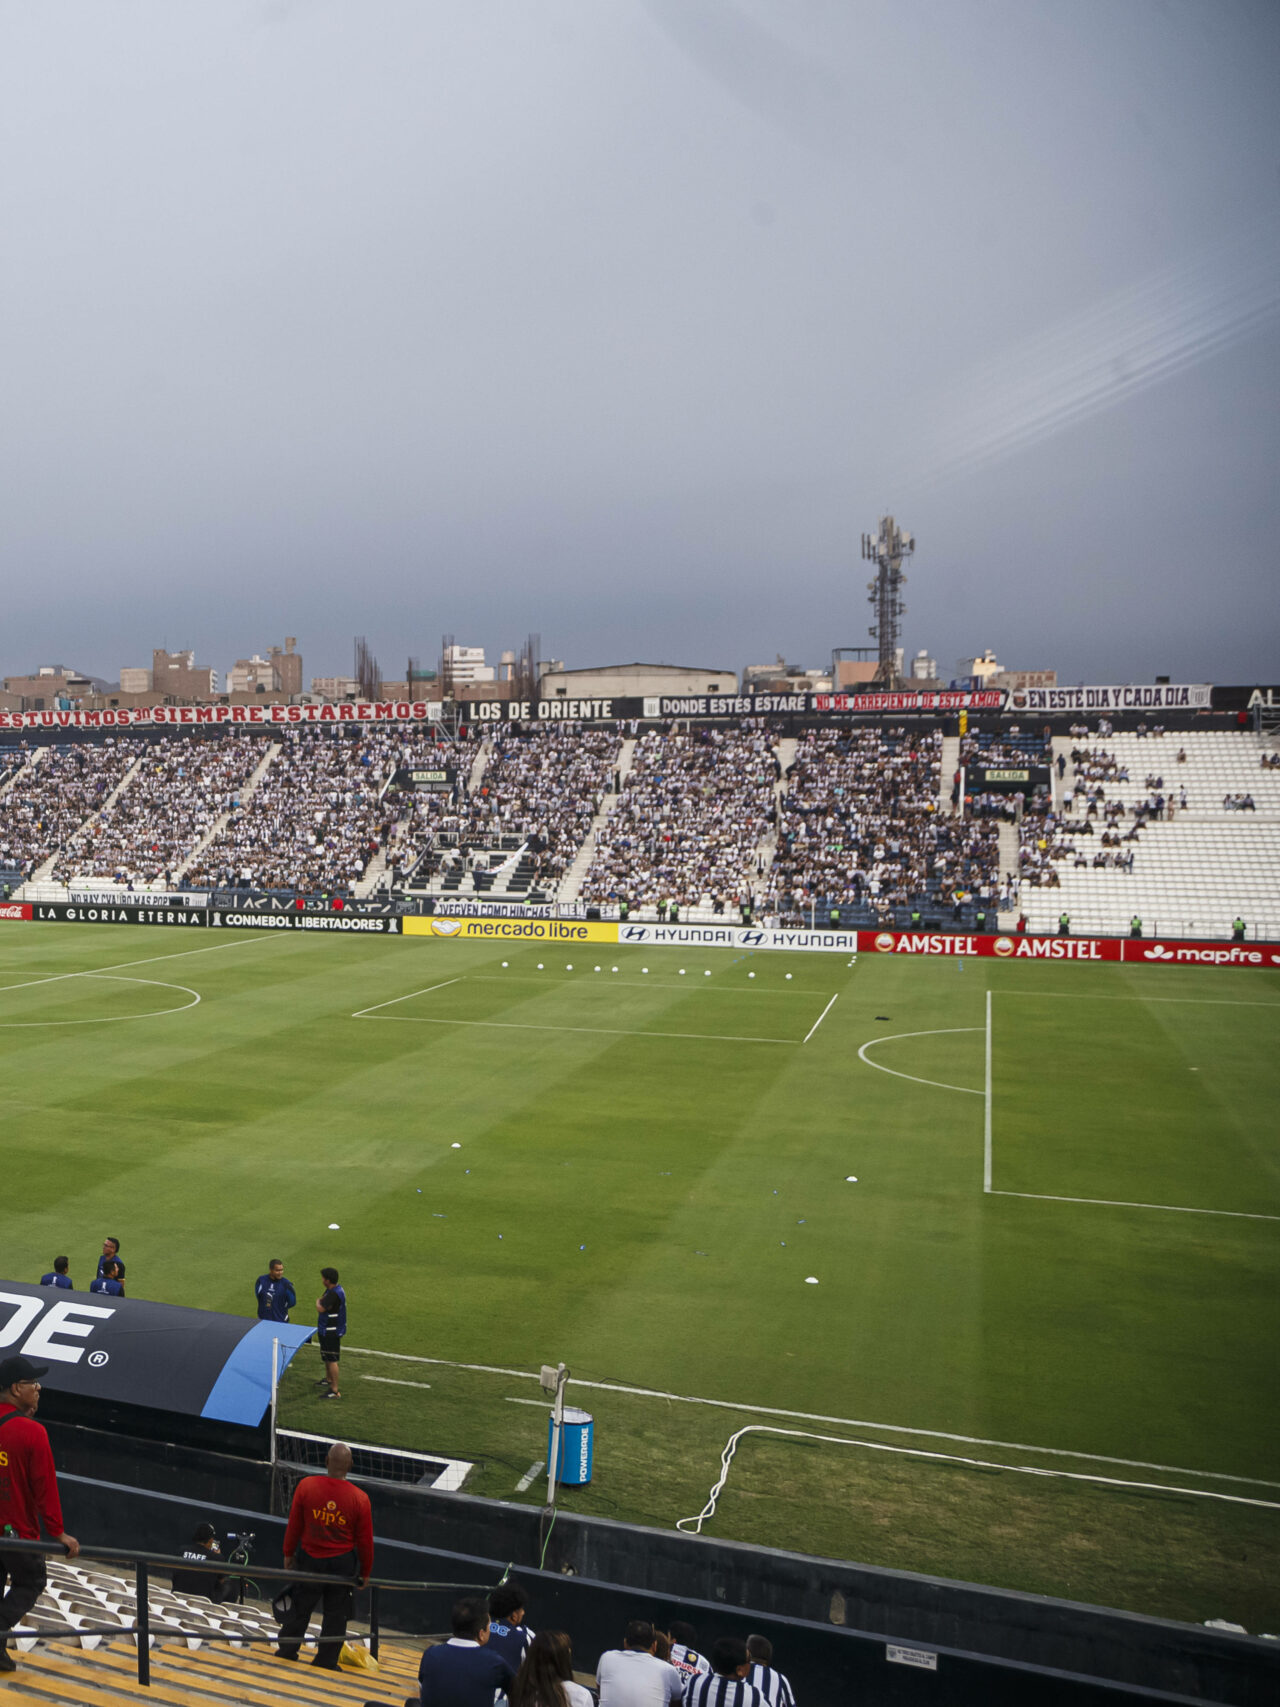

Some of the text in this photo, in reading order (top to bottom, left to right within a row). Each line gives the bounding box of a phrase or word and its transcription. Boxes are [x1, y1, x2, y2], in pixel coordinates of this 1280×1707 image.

[663, 695, 806, 714] DONDE ESTÉS ESTARÉ
[815, 691, 1002, 711] NO ME ARREPIENTO DE ESTE AMOR
[1028, 687, 1190, 708] EN ESTE DIA Y CADA DIA
[153, 705, 265, 724] SIEMPRE
[271, 701, 428, 721] ESTAREMOS
[470, 700, 613, 720] LOS DE ORIENTE
[415, 772, 443, 780] SALIDA
[989, 771, 1026, 780] SALIDA
[39, 908, 200, 924] LA GLORIA ETERNA
[481, 905, 507, 916] COMO
[510, 905, 550, 918] HINCHAS
[226, 914, 384, 930] CONMEBOL LIBERTADORES
[467, 922, 588, 938] mercado libre
[655, 929, 732, 942] HYUNDAI
[773, 934, 853, 947] HYUNDAI
[897, 934, 977, 954] AMSTEL
[1017, 940, 1101, 959] AMSTEL
[1177, 947, 1262, 964] mapfre
[580, 1427, 589, 1482] POWERADE
[312, 1507, 347, 1526] vip's
[183, 1551, 207, 1561] STAFF
